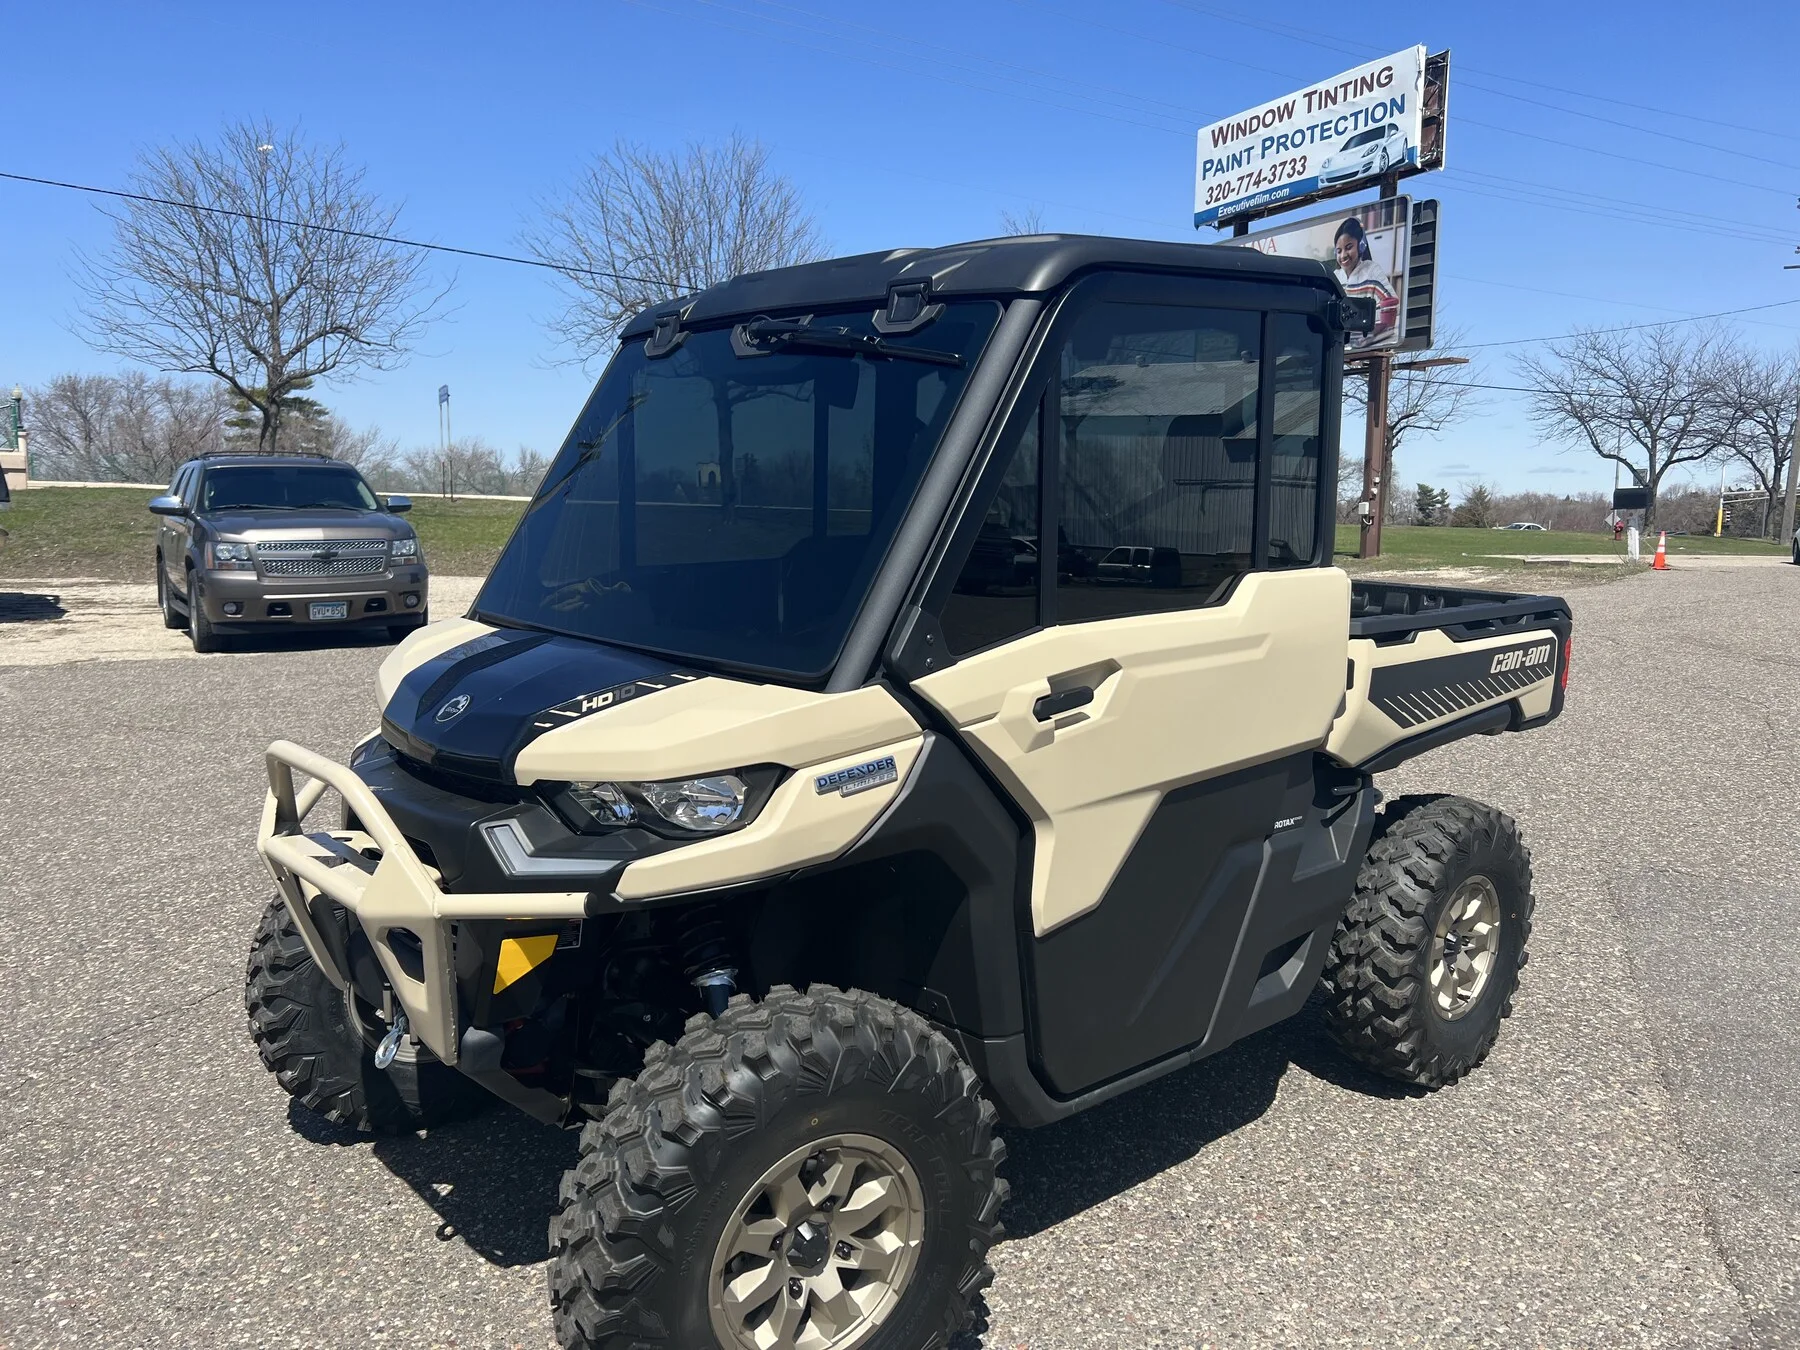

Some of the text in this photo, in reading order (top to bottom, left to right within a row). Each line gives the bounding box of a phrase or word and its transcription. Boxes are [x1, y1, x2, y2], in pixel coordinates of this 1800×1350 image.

[1211, 66, 1393, 148] WINDOW TINTING
[1202, 93, 1405, 180] PAINT PROTECTION
[1205, 155, 1307, 205] 320-774-3733
[1218, 187, 1289, 217] Executivefilm.com
[582, 684, 636, 713] HD10
[817, 758, 895, 787] DEFENDER
[1273, 817, 1295, 829] ROTAX
